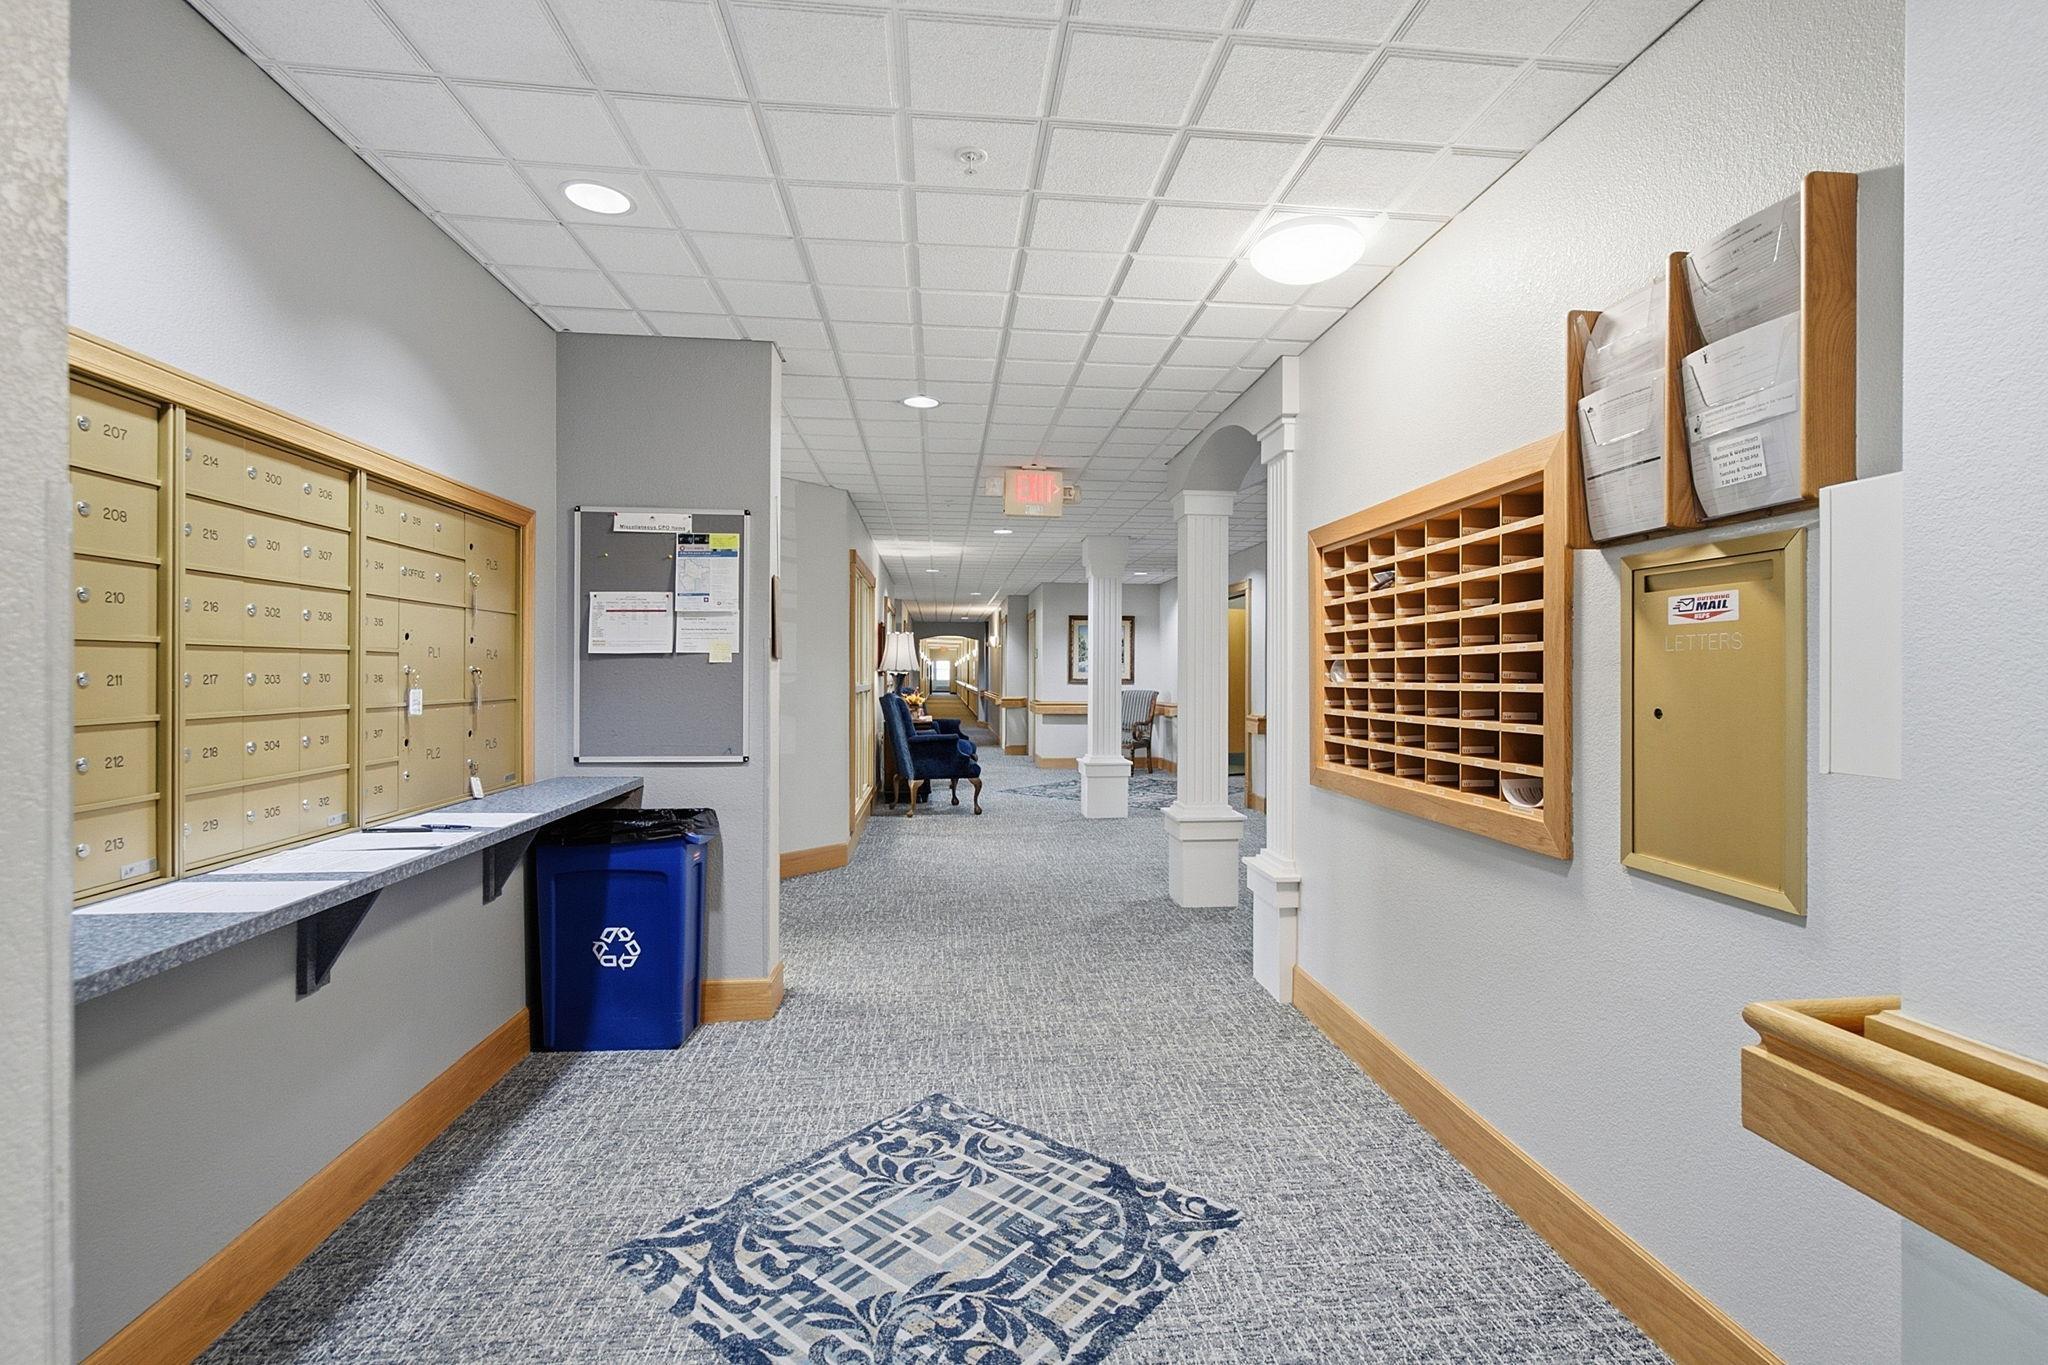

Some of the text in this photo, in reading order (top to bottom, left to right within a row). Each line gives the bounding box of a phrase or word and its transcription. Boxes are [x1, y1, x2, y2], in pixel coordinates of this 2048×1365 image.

[103, 424, 127, 440] 207
[202, 455, 219, 468] 214
[265, 472, 282, 486] 300
[318, 488, 333, 500] 306
[103, 507, 127, 522] 208
[202, 529, 219, 541] 215
[266, 540, 281, 551] 301
[318, 550, 332, 561] 307
[486, 558, 498, 571] PL3
[105, 591, 125, 604] 210
[1697, 593, 1730, 601] OUTGOING
[203, 601, 219, 613] 216
[1696, 599, 1729, 611] MAIL
[265, 606, 281, 618] 302
[318, 610, 332, 622] 308
[1665, 631, 1744, 652] LETTERS
[428, 646, 441, 659] PL1
[487, 648, 498, 660] PL4
[107, 674, 123, 686] 211
[203, 674, 218, 685] 217
[265, 674, 281, 685] 303
[319, 673, 331, 683] 310
[373, 729, 383, 738] 317
[264, 740, 280, 751] 304
[320, 735, 329, 745] 311
[202, 746, 218, 758] 218
[426, 747, 440, 760] PL2
[105, 756, 124, 769] 212
[318, 797, 330, 807] 312
[264, 806, 280, 818] 305
[202, 819, 218, 831] 219
[104, 838, 124, 852] 213
